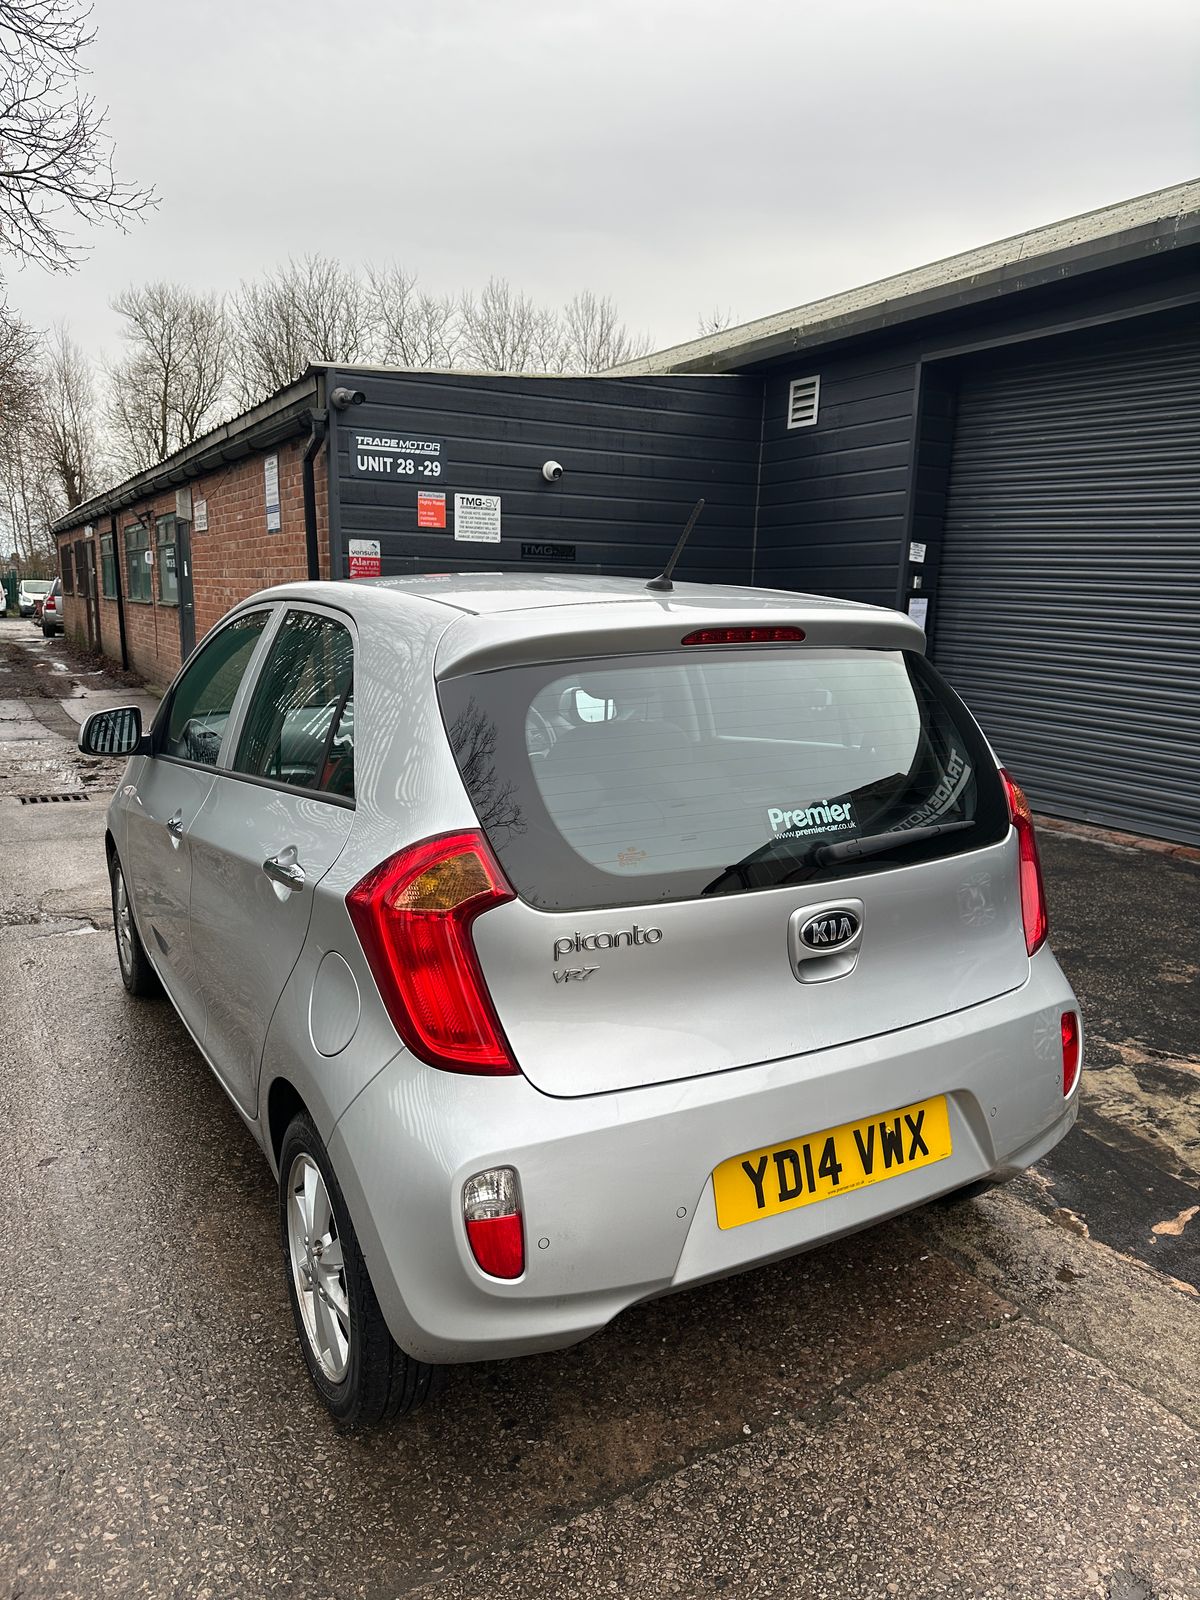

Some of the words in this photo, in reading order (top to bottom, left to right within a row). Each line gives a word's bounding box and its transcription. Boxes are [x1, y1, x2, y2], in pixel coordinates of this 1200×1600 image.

[357, 455, 393, 472] UNIT
[397, 459, 414, 474] 28
[351, 557, 379, 566] Alarm
[767, 799, 851, 831] Premier
[774, 821, 857, 839] www.premier-car.co.uk
[812, 917, 852, 943] KIA
[553, 924, 663, 961] picanto
[553, 965, 600, 983] VR7
[742, 1136, 842, 1208] YD14
[853, 1110, 929, 1175] VWX
